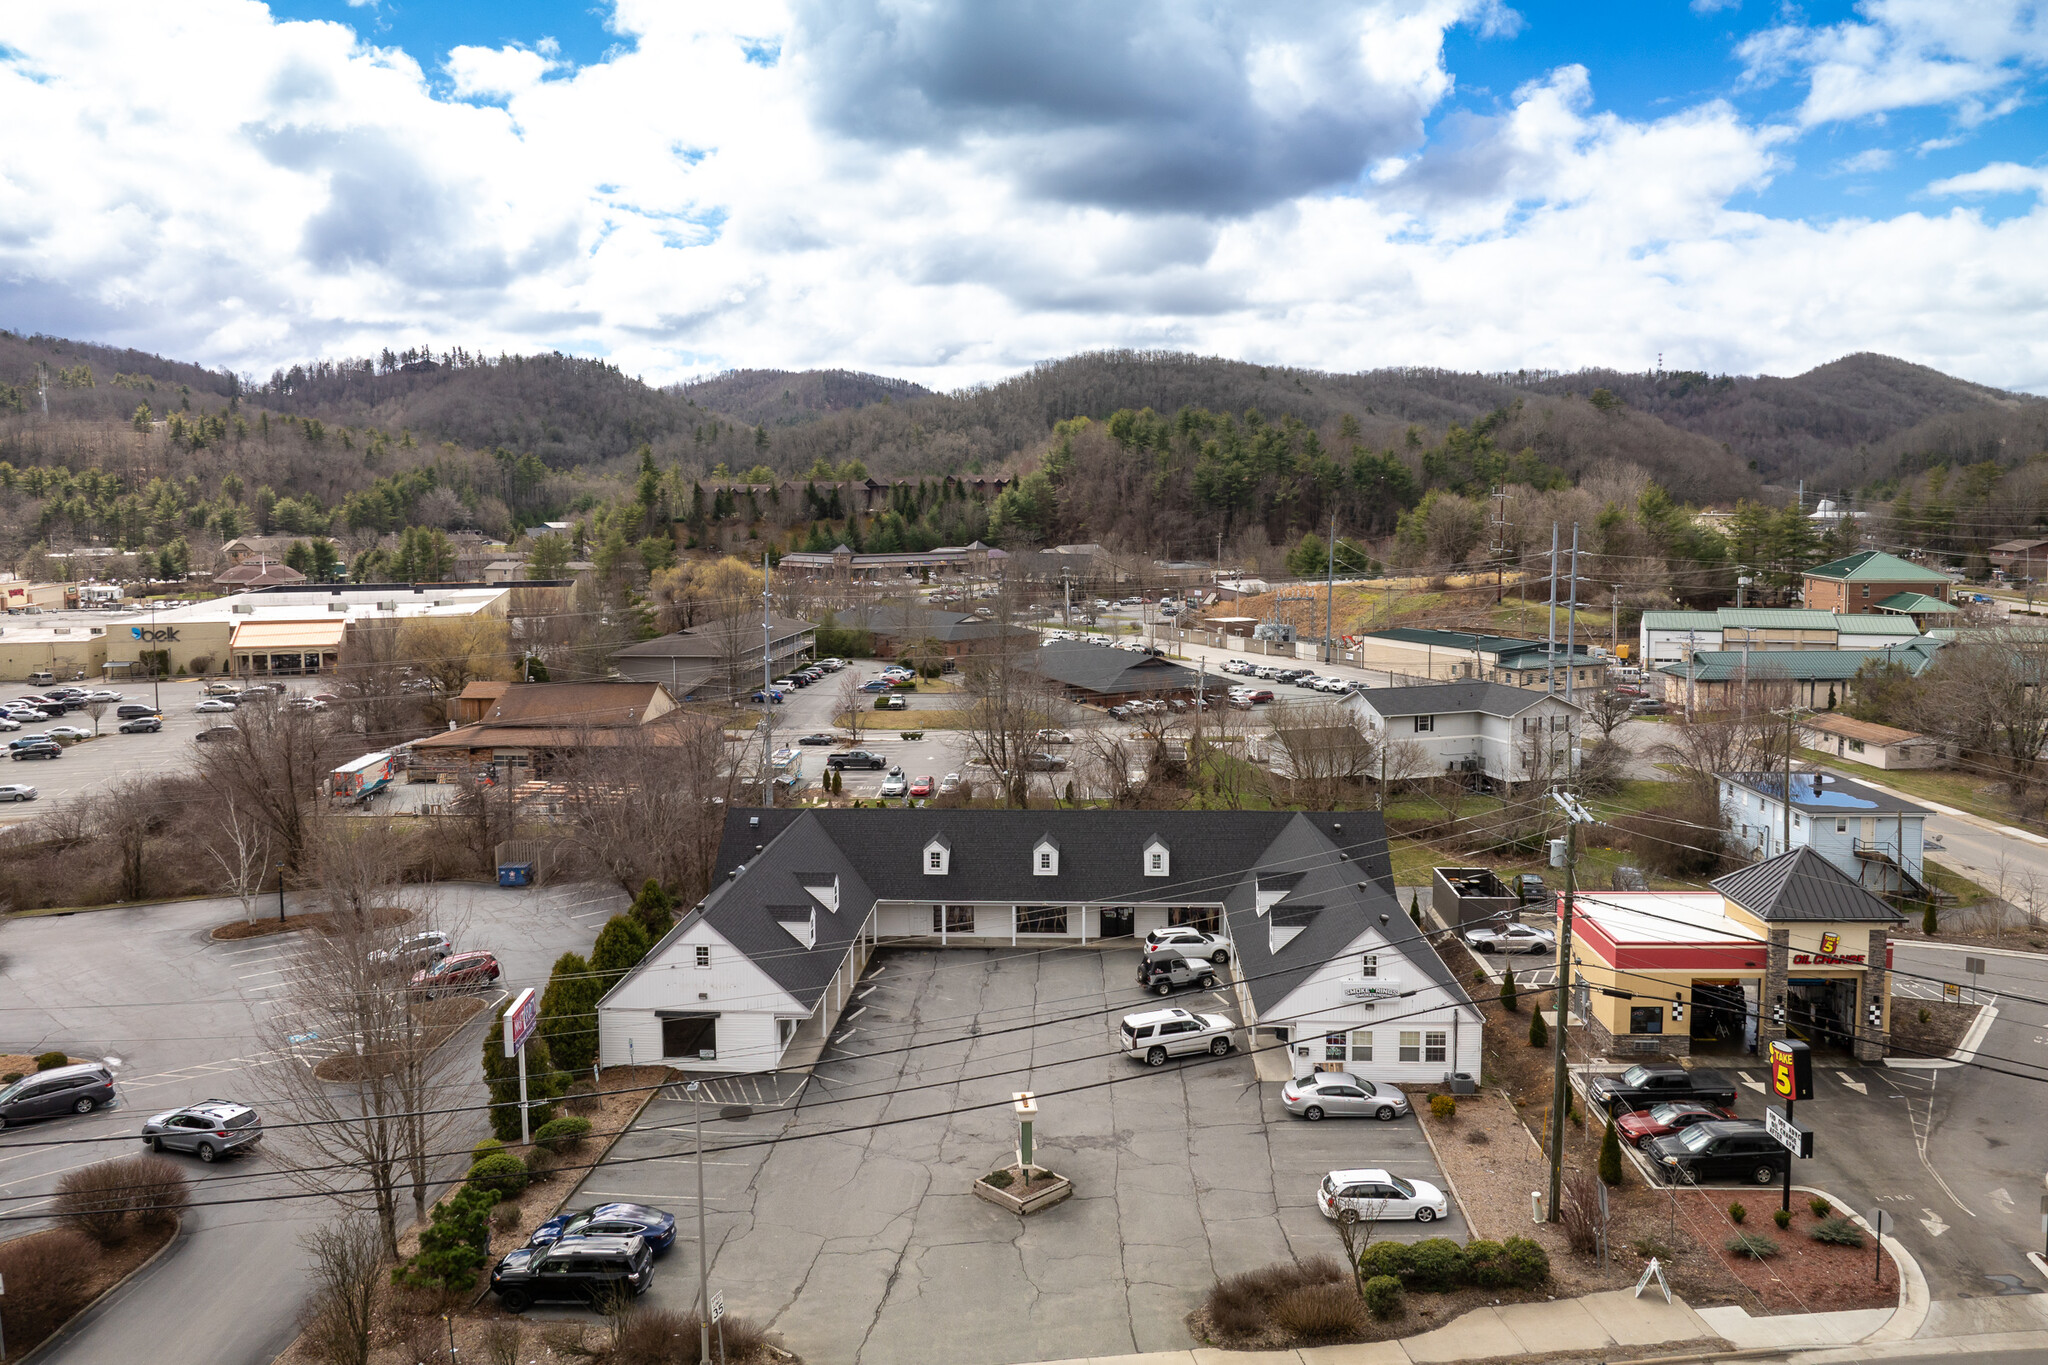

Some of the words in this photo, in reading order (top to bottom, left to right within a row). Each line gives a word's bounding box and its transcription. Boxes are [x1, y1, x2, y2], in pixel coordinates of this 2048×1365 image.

[141, 626, 181, 643] belk
[1823, 941, 1834, 953] 5
[1793, 954, 1812, 965] OIL
[1813, 954, 1866, 965] CHANGE
[1345, 988, 1371, 996] SMOKE
[1375, 987, 1399, 996] RINGS
[1774, 1050, 1793, 1066] TAKE
[1776, 1064, 1791, 1095] 5
[1769, 1126, 1783, 1141] AFTER
[1771, 1121, 1779, 1131] OIL
[1780, 1127, 1797, 1146] CHANGE
[1874, 1194, 1916, 1202] ONLY
[712, 1302, 724, 1319] 35
